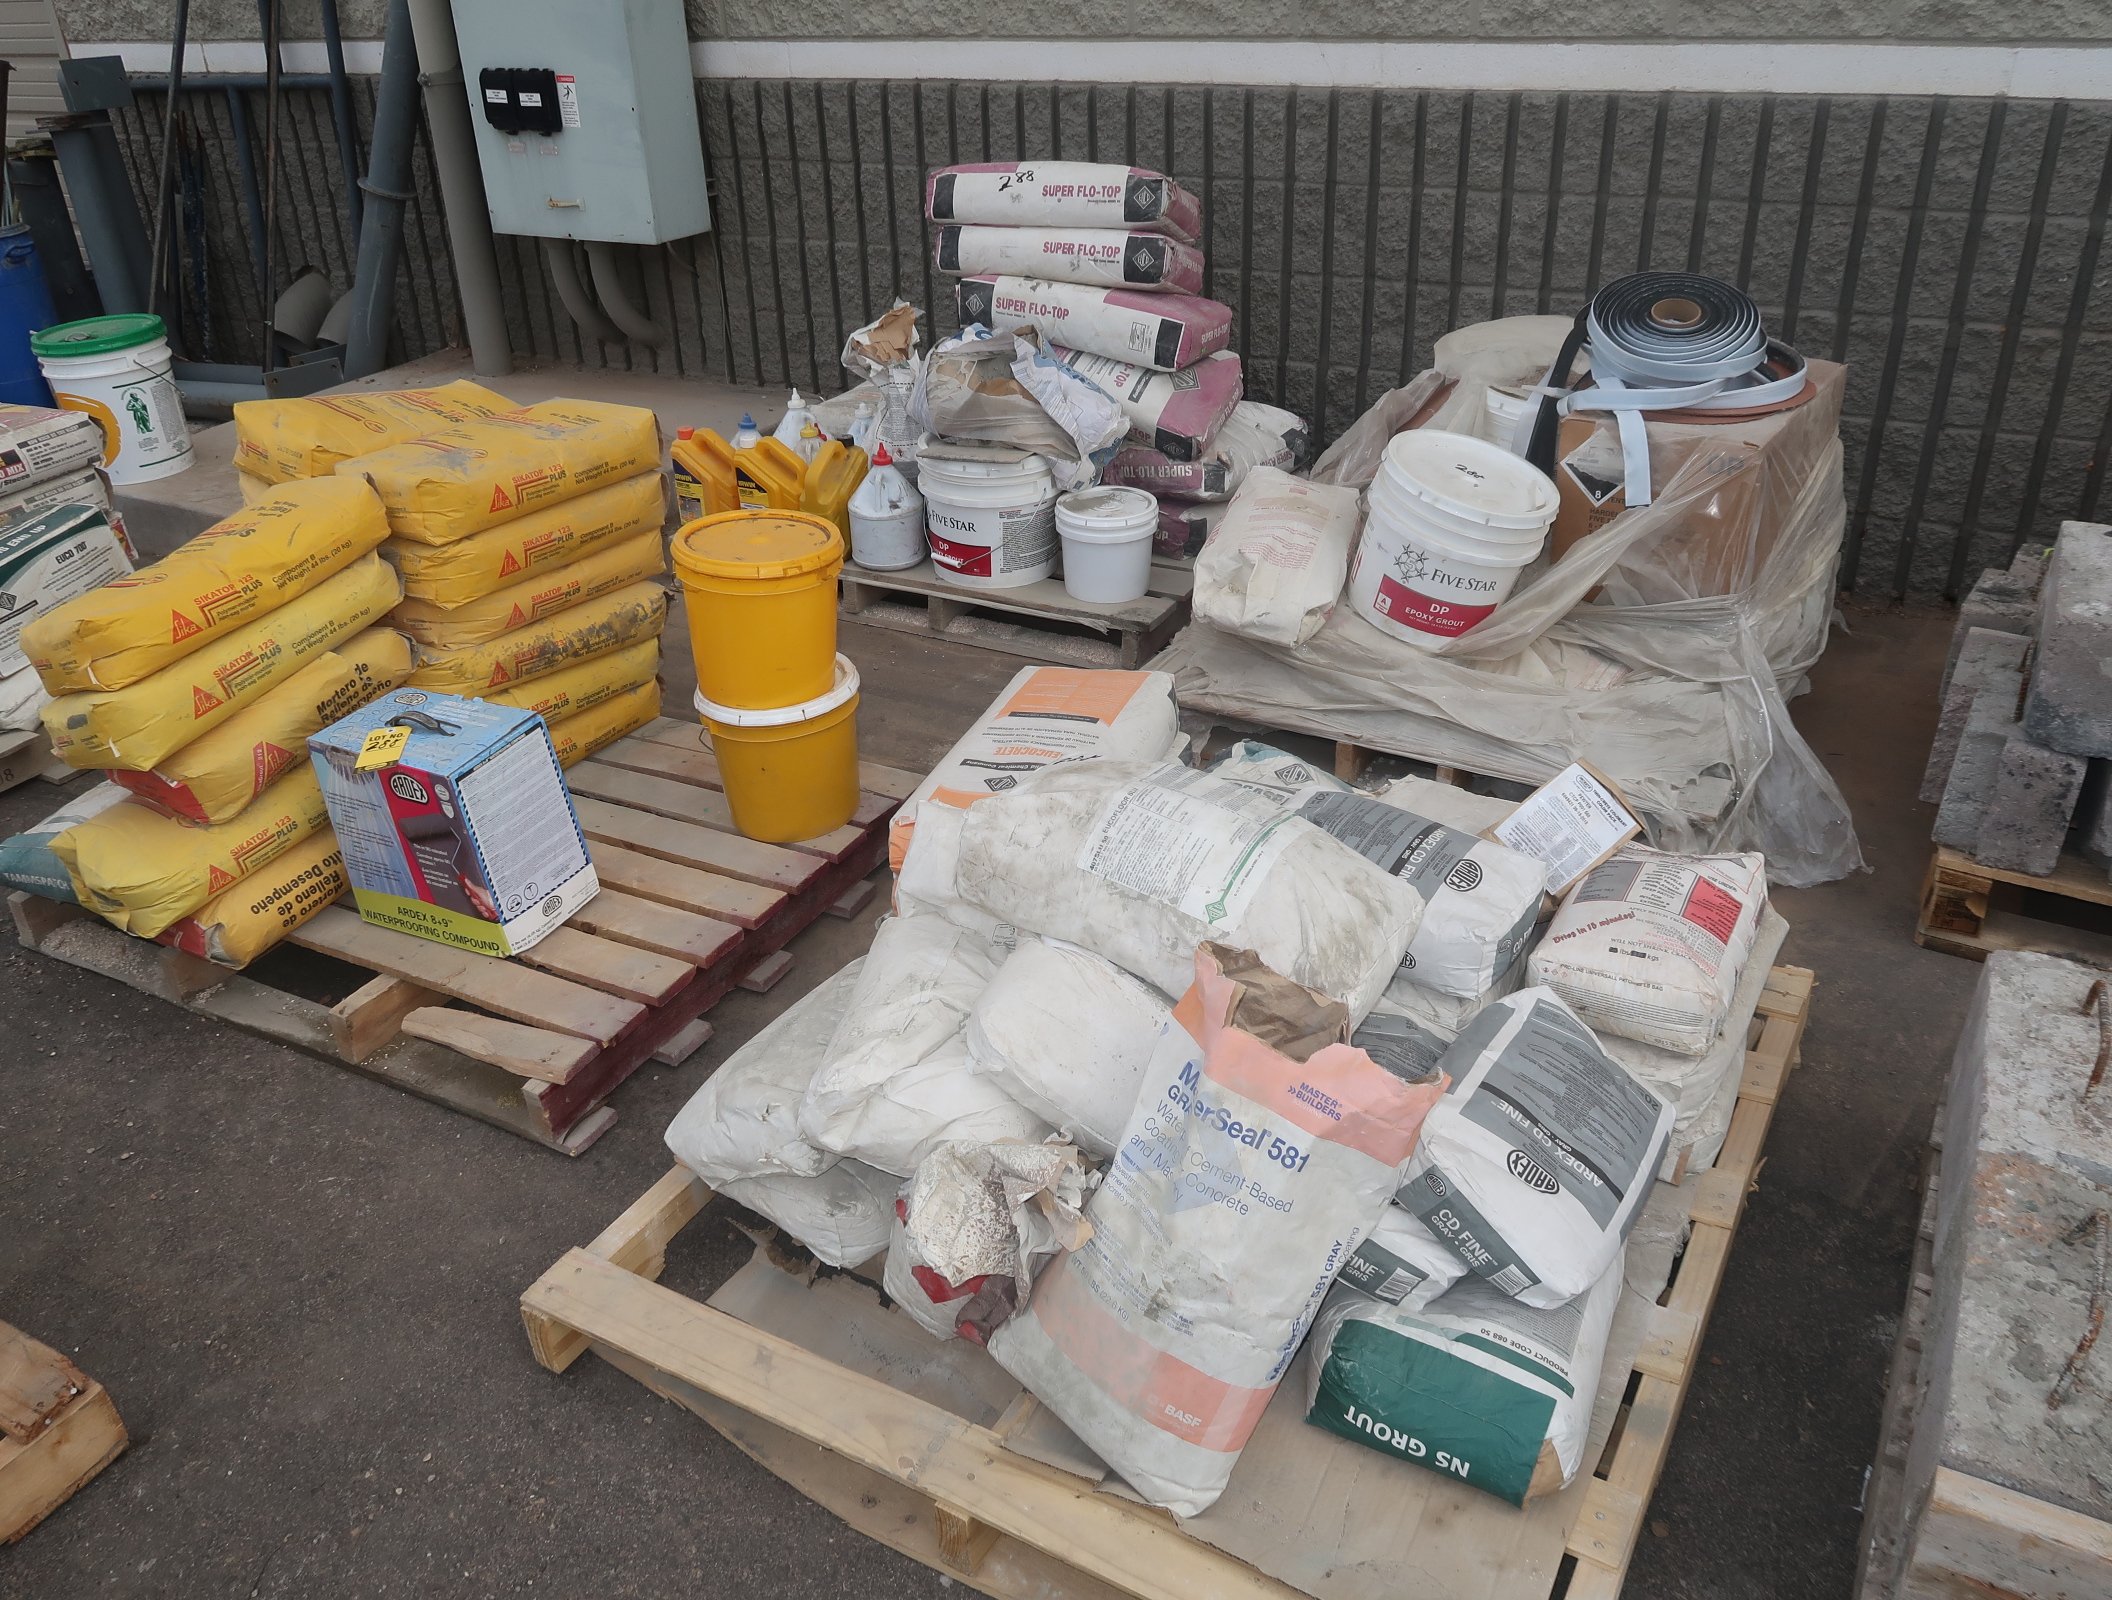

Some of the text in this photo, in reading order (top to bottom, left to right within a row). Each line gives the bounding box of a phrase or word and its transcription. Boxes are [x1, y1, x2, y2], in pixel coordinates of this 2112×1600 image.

[998, 170, 1035, 192] 288
[1042, 184, 1122, 199] SUPER FLO-TOP
[1042, 241, 1121, 258] SUPER FLO-TOP
[995, 296, 1027, 314] SUPER
[1028, 302, 1070, 321] FLO-TOP
[7, 462, 25, 476] MIX
[511, 462, 563, 485] SIKATOP 123
[549, 469, 567, 483] PLUS
[574, 461, 610, 480] Component B
[575, 477, 586, 486] Net
[585, 471, 603, 485] Weight
[602, 468, 609, 476] 44
[1157, 463, 1194, 478] SUPER
[492, 493, 511, 511] Sika
[1594, 490, 1602, 499] 8
[931, 509, 977, 533] FIVE STAR
[1589, 508, 1619, 517] HARDEN
[522, 525, 571, 550] SIKATOP 123
[557, 531, 575, 545] PLUS
[938, 541, 949, 551] DP
[55, 548, 75, 565] EUCO
[193, 573, 254, 607] SIKATOP 123
[241, 578, 264, 596] PLUS
[1430, 567, 1497, 592] FIVE STAR
[1404, 606, 1466, 628] EPOXY GROUT
[1429, 603, 1450, 615] DP
[173, 618, 199, 641] Sika
[291, 619, 336, 650] Component B
[294, 606, 371, 657] Net Weight 44 lbs. (20 kg)
[212, 638, 275, 679] SIKATOP 123
[259, 644, 283, 664] PLUS
[196, 694, 219, 715] Sika
[315, 677, 357, 716] Mortero
[320, 690, 360, 725] Relleno
[368, 734, 387, 742] LOT
[267, 748, 290, 775] Sika
[993, 746, 1063, 760] EUCOCRETE
[391, 774, 428, 803] ARDEX
[1577, 793, 1592, 809] PEWTER
[1102, 794, 1130, 834] EUCOFLOOR
[1606, 812, 1618, 824] PACK
[230, 814, 292, 857] SIKATOP 123
[275, 820, 299, 840] PLUS
[1409, 828, 1448, 865] ARDEX CD
[3, 871, 71, 890] TAMMSPATCH
[210, 871, 233, 892] Sika
[295, 869, 341, 905] Relleno
[1446, 860, 1481, 891] ARDEX
[250, 864, 324, 916] Desempeño
[276, 902, 294, 917] de
[282, 881, 344, 929] Mortero de
[397, 905, 428, 923] ARDEX
[543, 896, 562, 916] ARDEX
[364, 907, 441, 939] WATERPROOFING
[441, 930, 500, 952] COMPOUND
[1577, 924, 1587, 935] in
[1587, 920, 1598, 931] 15
[1626, 939, 1642, 948] NOT
[1647, 953, 1660, 962] kgs
[1560, 963, 1585, 975] PRO-LINE
[1585, 968, 1618, 982] UNIVERSALL
[1295, 1091, 1343, 1121] BUILDERS
[1299, 1081, 1339, 1109] MASTER
[1130, 1133, 1152, 1159] and
[1498, 1099, 1604, 1188] ARDEX CD FINE
[1537, 1121, 1573, 1152] GRAY GRIS
[1267, 1136, 1311, 1173] 581
[1144, 1117, 1250, 1216] Coating Concrete
[1509, 1152, 1559, 1193] ARDEX
[1190, 1151, 1294, 1213] Cement-Based
[1427, 1174, 1446, 1197] ARDEX
[1337, 1226, 1360, 1264] Coating
[1431, 1215, 1482, 1269] GRAY GRIS
[1438, 1208, 1493, 1267] CD FINE
[1070, 1253, 1083, 1271] WT
[1310, 1239, 1343, 1298] 581 GRAY
[1345, 1266, 1370, 1282] GRIS
[1480, 1327, 1570, 1377] PRODUCT CODE 088 50
[1164, 1403, 1203, 1427] BASF
[1343, 1403, 1472, 1479] NS GROUT
